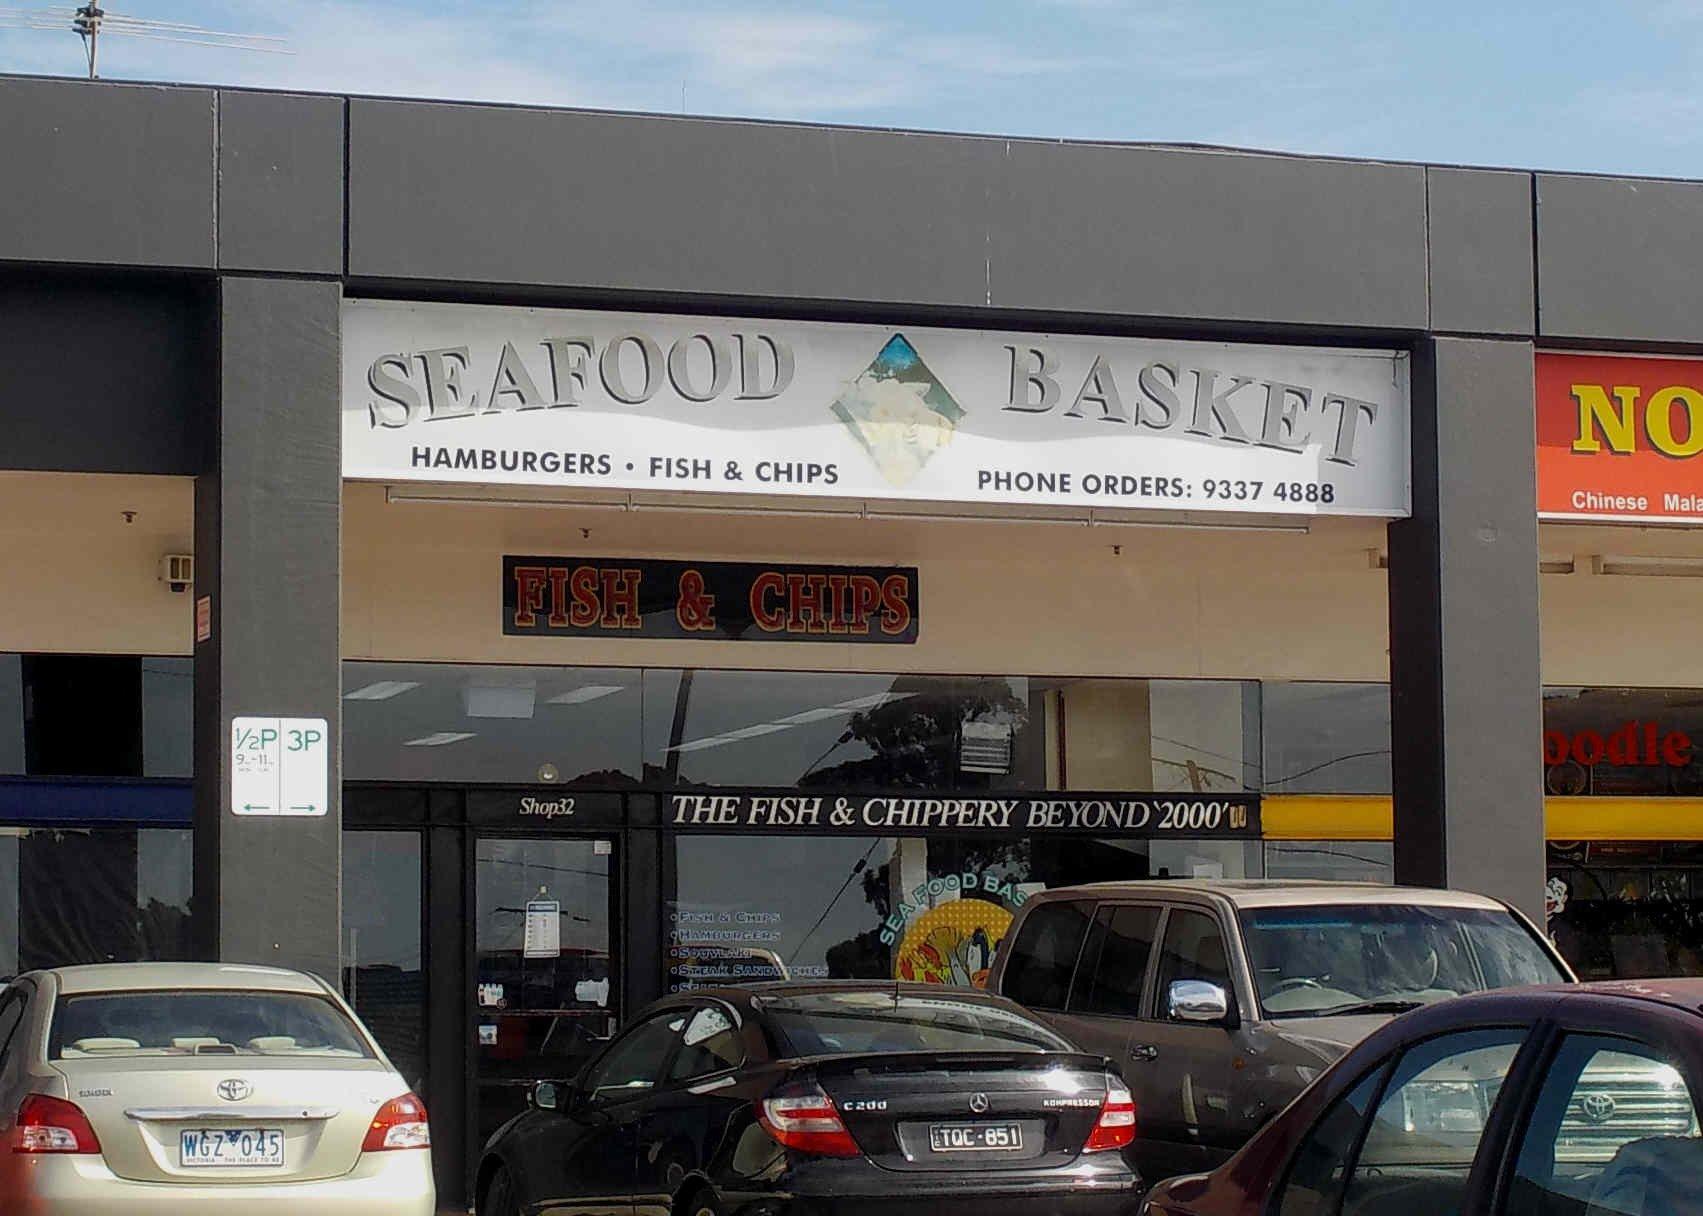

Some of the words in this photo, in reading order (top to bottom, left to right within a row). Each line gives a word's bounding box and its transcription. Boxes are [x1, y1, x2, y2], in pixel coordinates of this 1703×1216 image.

[368, 333, 796, 431] SEAFOOD
[1001, 343, 1379, 468] BASKET
[411, 445, 612, 475] HAMBURGERS
[649, 456, 712, 481] FISH
[723, 460, 744, 482] &
[755, 461, 839, 485] CHIPS
[978, 470, 1072, 494] PHONE
[1082, 474, 1192, 499] ORDERS:
[1202, 478, 1263, 501] 9337
[1273, 482, 1335, 504] 4888
[1571, 490, 1648, 511] Chinese
[514, 565, 641, 629] FISH
[675, 569, 716, 631] &
[749, 571, 911, 635] CHIPS
[287, 729, 321, 752] 3P
[519, 797, 575, 820] Shop32
[672, 795, 741, 824] THE
[746, 797, 823, 826] FISH
[829, 797, 856, 826] &
[862, 798, 1020, 828] CHIPPERY
[1026, 800, 1150, 829] BEYOND
[678, 911, 714, 923] FISH
[719, 911, 731, 923] &
[735, 911, 782, 924] CHIPS
[678, 928, 782, 941] HAMBURGERS
[678, 964, 729, 977] STEAK
[184, 1134, 224, 1157] WGZ
[241, 1134, 279, 1157] 045
